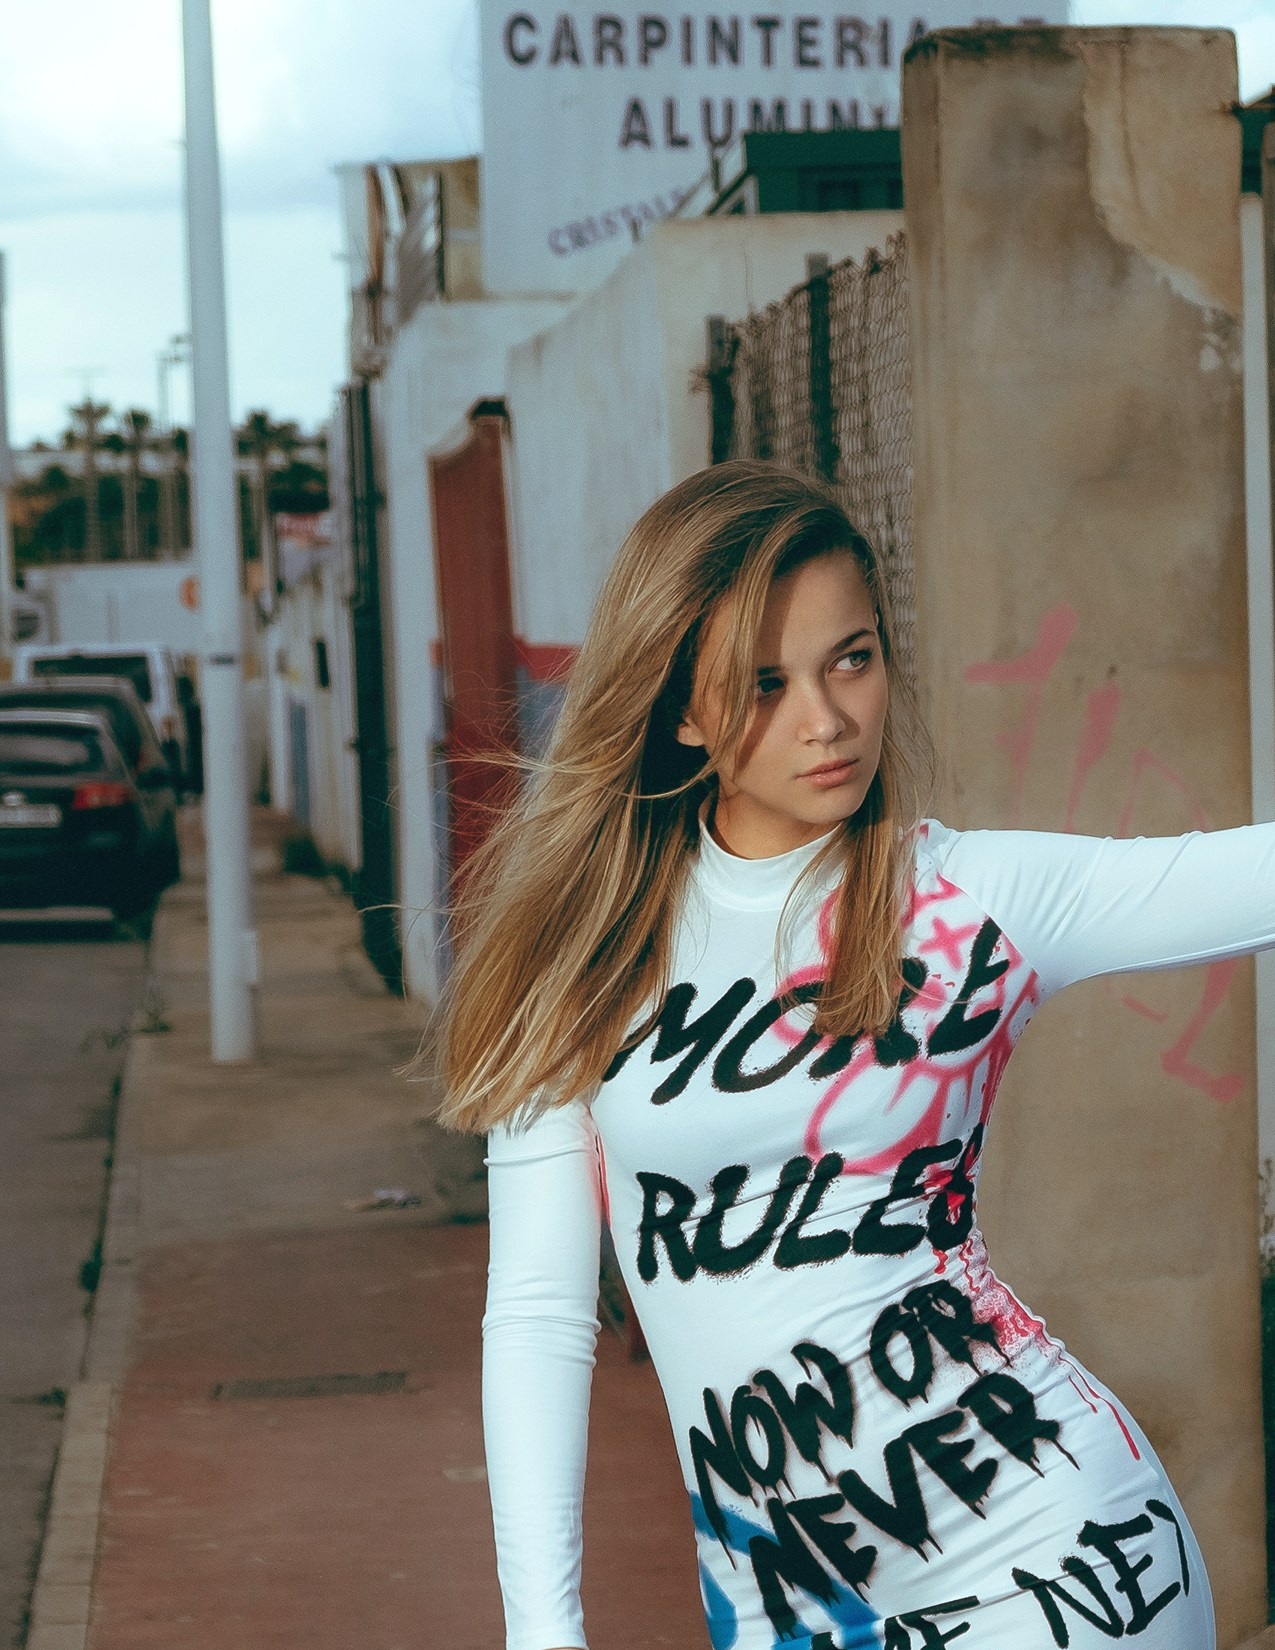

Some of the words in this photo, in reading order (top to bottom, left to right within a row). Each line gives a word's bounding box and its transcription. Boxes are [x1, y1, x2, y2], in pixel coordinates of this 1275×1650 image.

[688, 1339, 857, 1570] NOW
[868, 1279, 1012, 1410] OR
[747, 1371, 1081, 1643] NEVER
